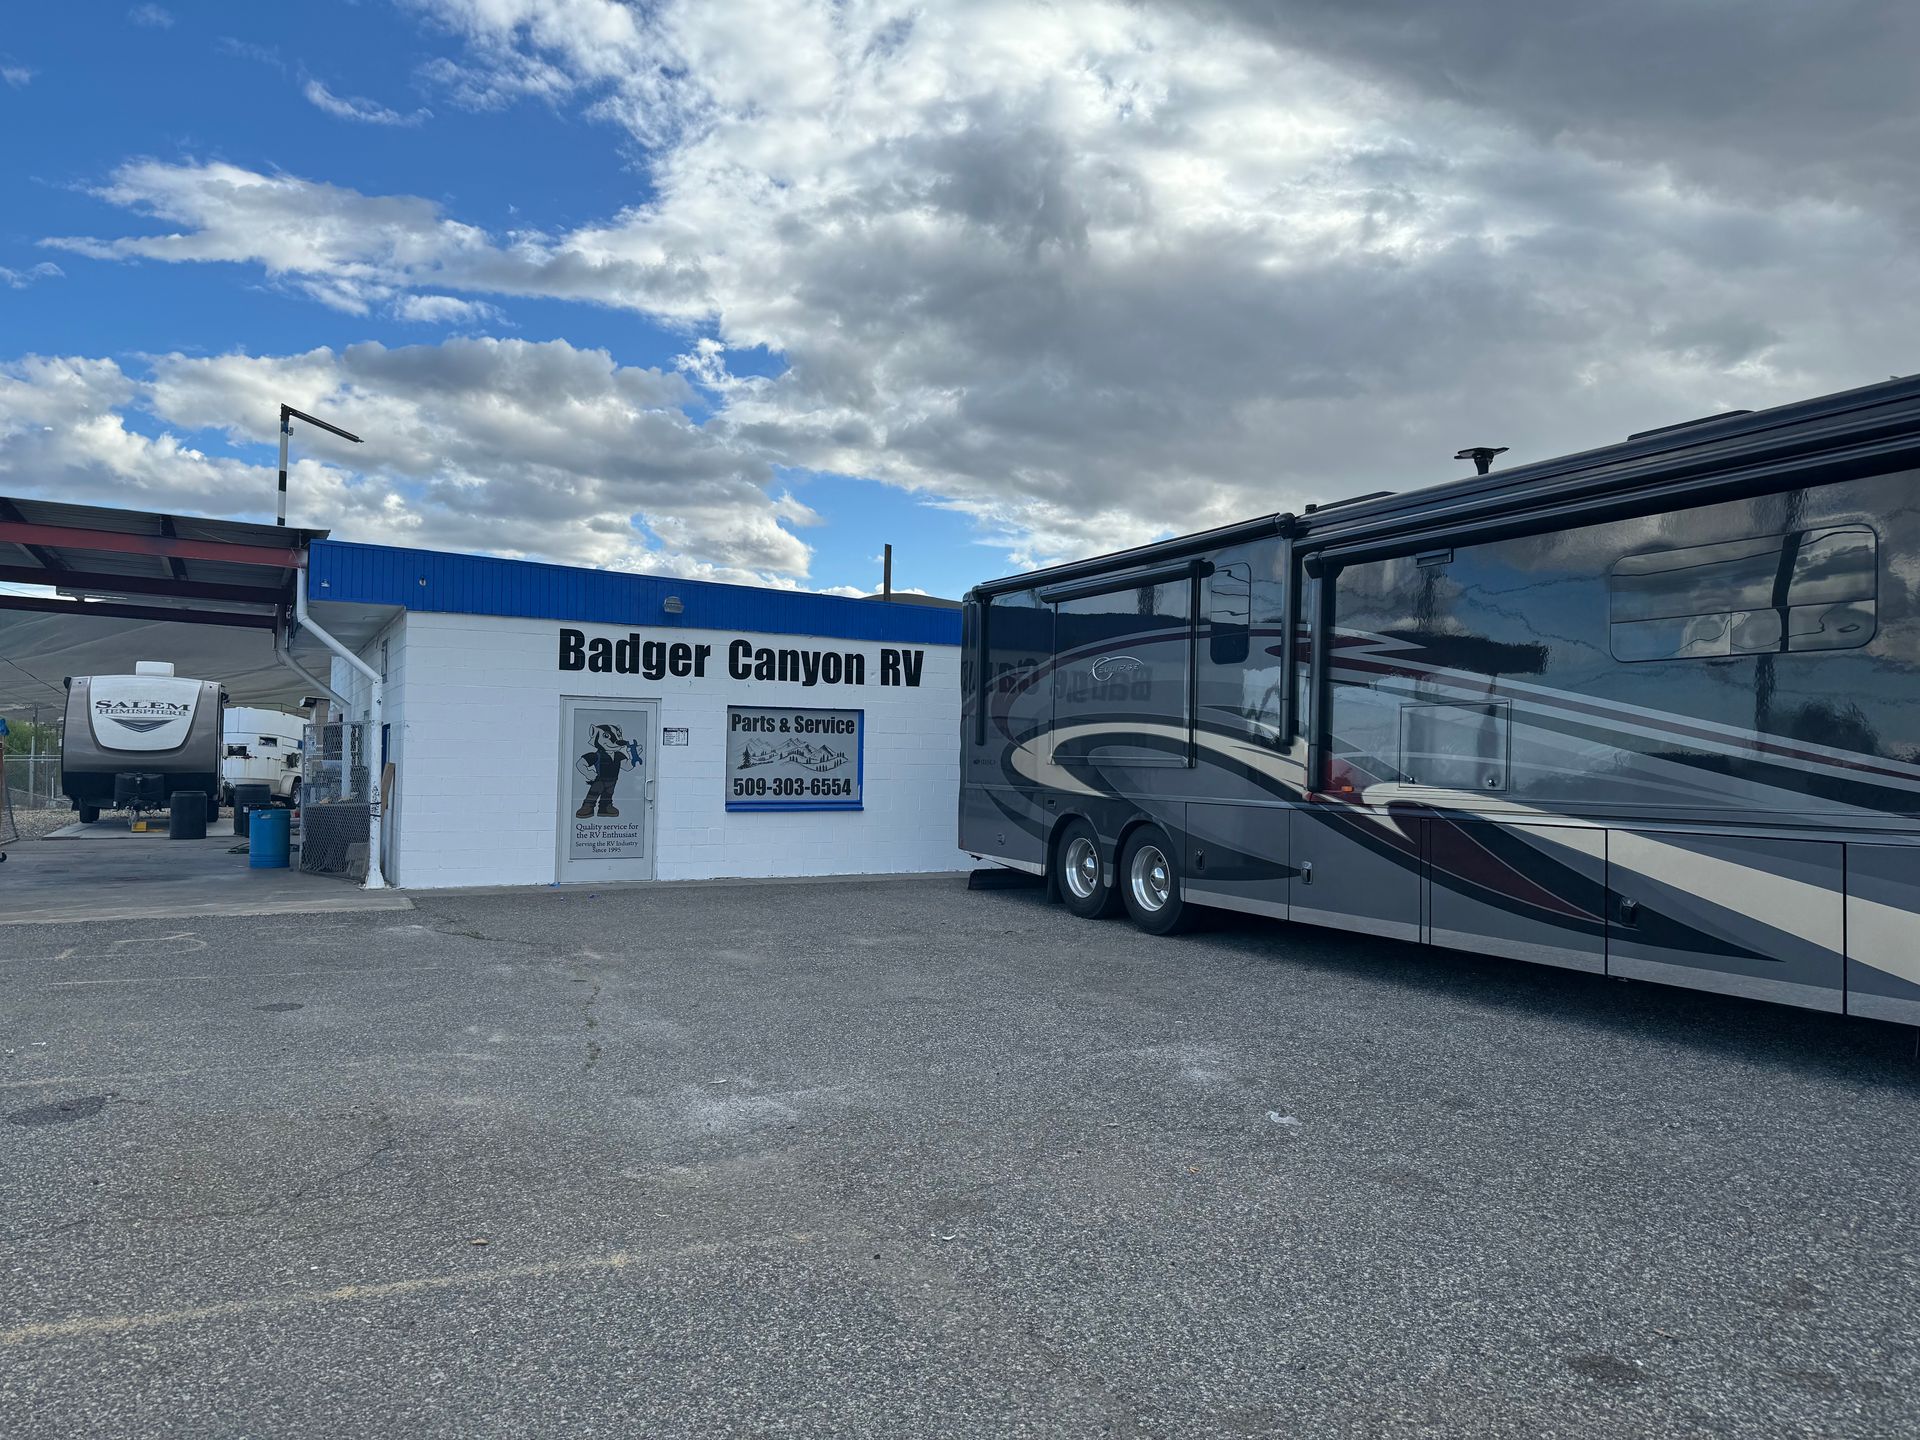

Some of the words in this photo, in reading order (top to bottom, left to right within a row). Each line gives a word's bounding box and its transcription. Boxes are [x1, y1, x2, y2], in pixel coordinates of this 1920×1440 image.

[559, 628, 711, 681] Badger
[728, 639, 865, 687] Canyon
[880, 648, 925, 687] RV
[95, 700, 191, 711] SALEM
[98, 708, 187, 717] HEMISPHERE
[731, 713, 776, 733] Parts
[779, 717, 791, 733] &
[794, 715, 855, 734] Service
[733, 777, 852, 796] 509-303-6554
[576, 823, 602, 832] Quality
[576, 831, 588, 839] the
[589, 831, 601, 839] RV
